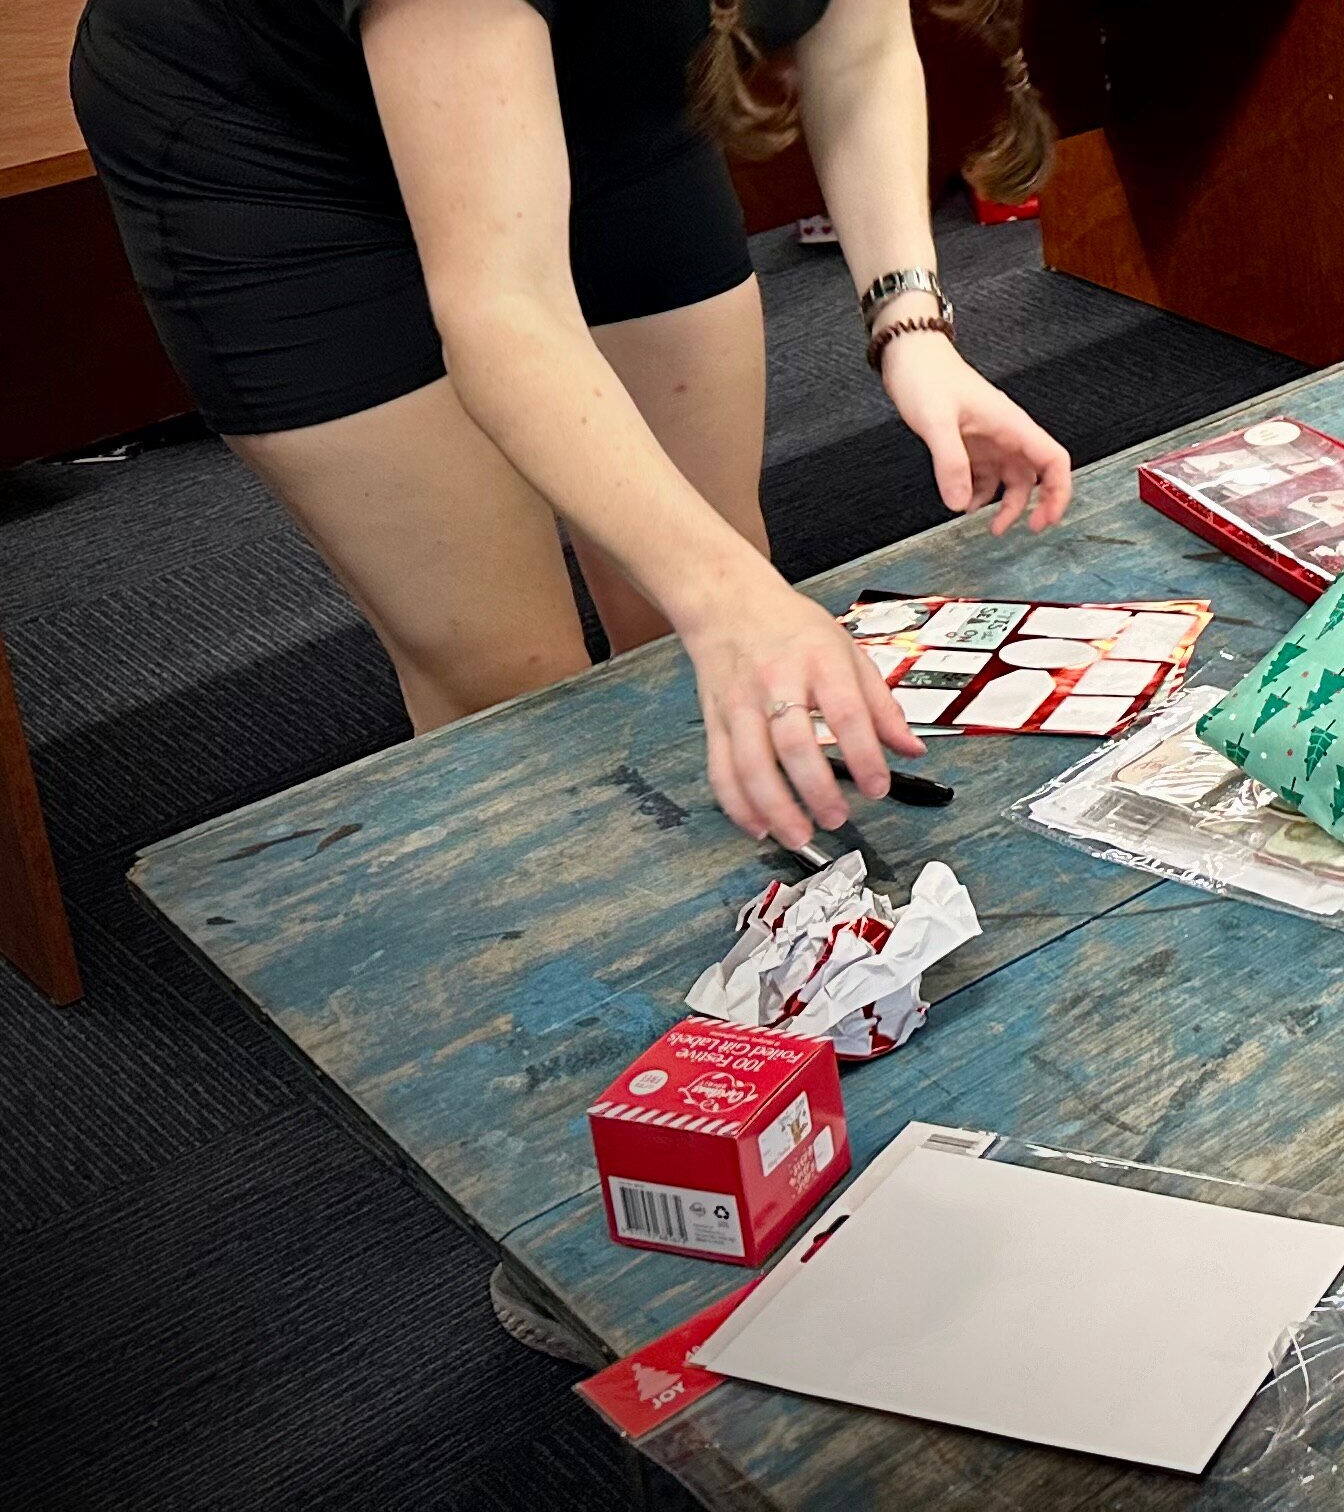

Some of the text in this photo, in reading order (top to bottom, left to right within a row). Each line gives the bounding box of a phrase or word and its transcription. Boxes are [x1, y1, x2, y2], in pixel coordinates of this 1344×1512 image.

[667, 1032, 720, 1051] Labels
[717, 1040, 751, 1056] Gift
[675, 1048, 766, 1073] 100 Festive
[747, 1045, 804, 1063] Foiled
